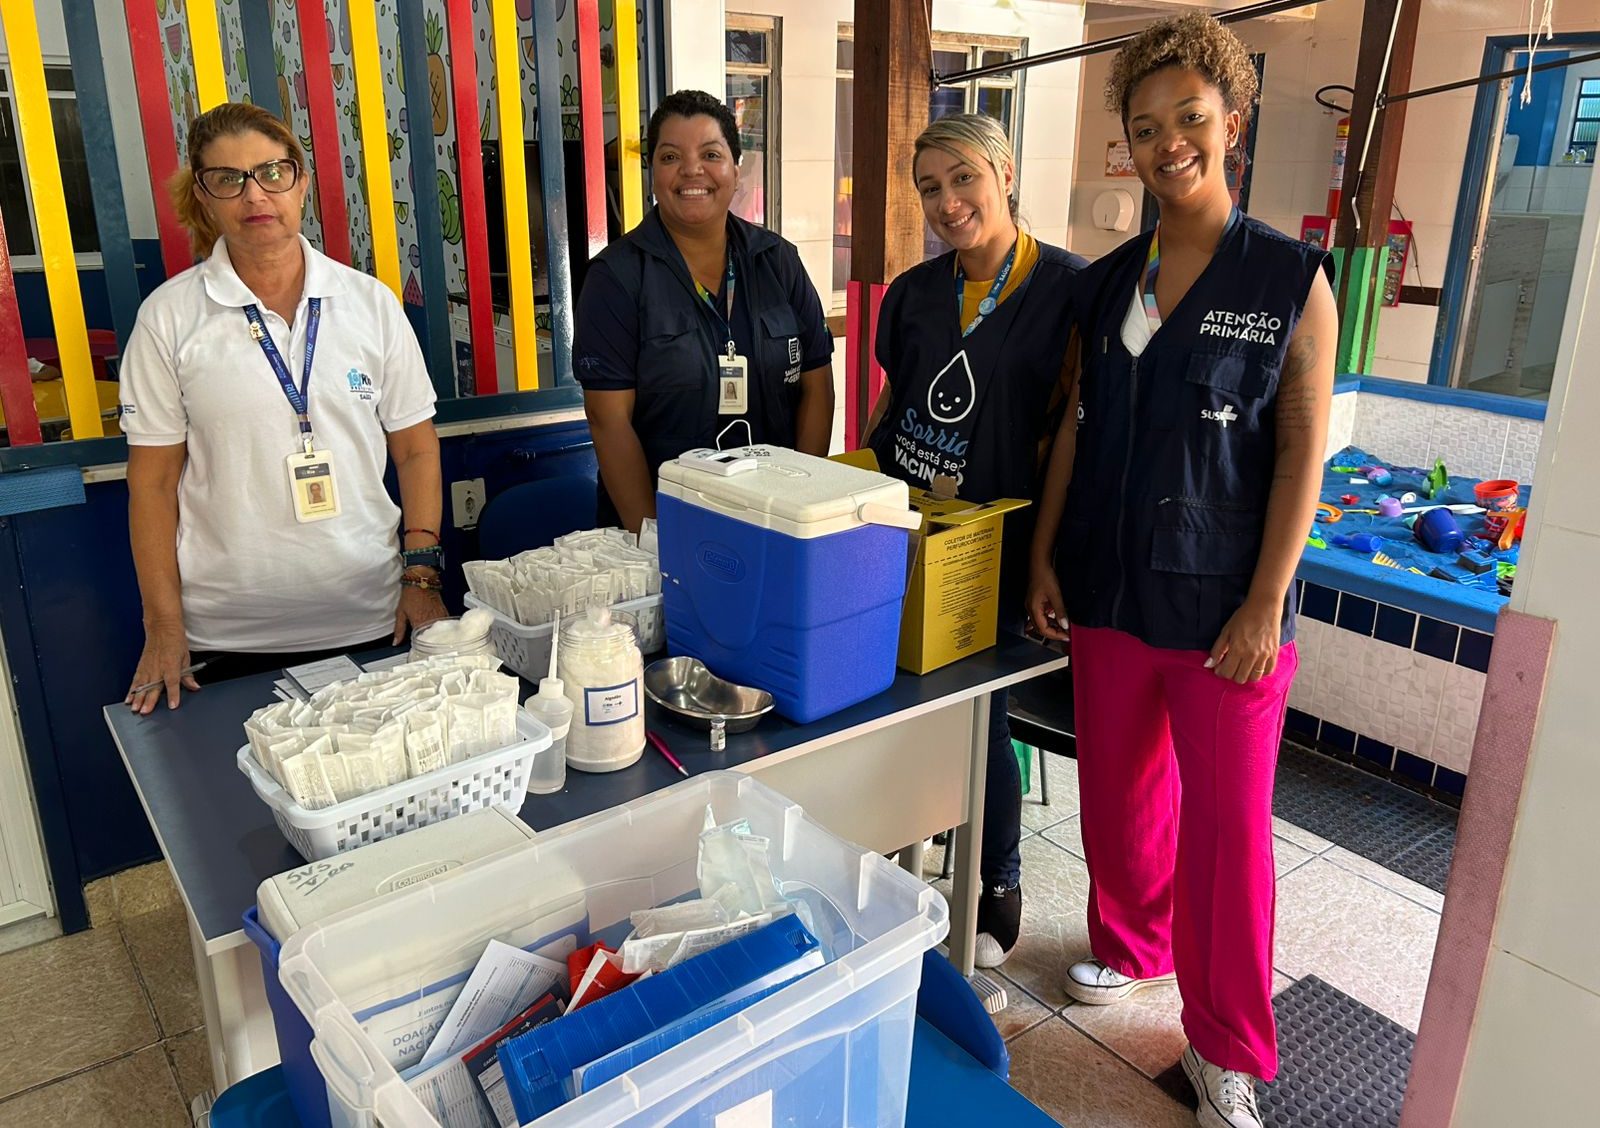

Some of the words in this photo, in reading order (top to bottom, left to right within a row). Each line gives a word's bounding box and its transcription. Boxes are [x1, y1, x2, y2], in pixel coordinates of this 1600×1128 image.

[1203, 310, 1281, 331] ATENÇÃO
[1200, 323, 1276, 346] PRIMÁRIA
[1201, 409, 1220, 421] SUS
[901, 408, 969, 456] Sorria
[896, 433, 916, 454] você
[917, 448, 941, 466] está
[944, 536, 965, 546] COLETOR
